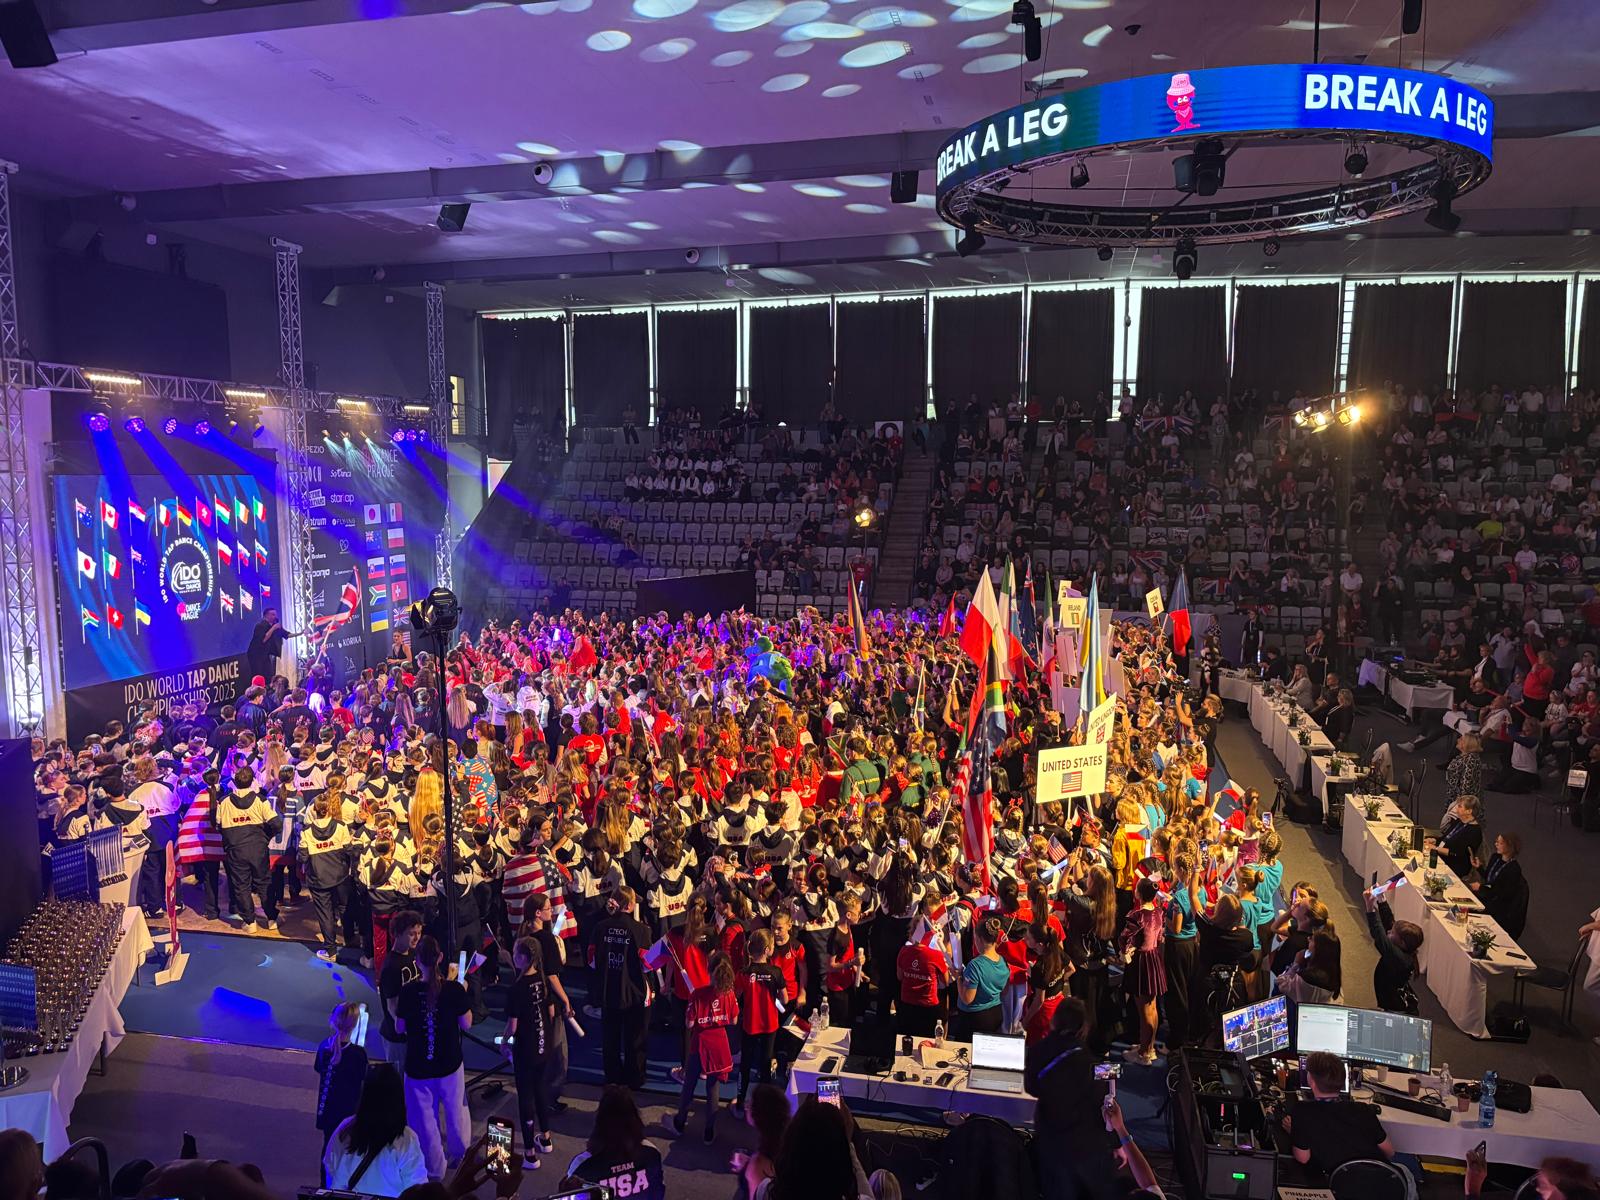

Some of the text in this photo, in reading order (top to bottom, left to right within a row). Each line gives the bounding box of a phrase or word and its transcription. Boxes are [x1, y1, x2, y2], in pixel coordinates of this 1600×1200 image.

[1304, 73, 1487, 136] BREAK A LEG
[981, 123, 1000, 157] A
[1007, 103, 1068, 148] LEG
[180, 564, 201, 581] IDO
[124, 660, 240, 705] IDO WORLD TAP DANCE
[213, 681, 236, 703] 2025
[1042, 755, 1103, 773] UNITED STATES
[232, 815, 252, 823] USA
[316, 841, 335, 850] USA
[667, 901, 686, 911] USA
[610, 1161, 635, 1173] TEAM
